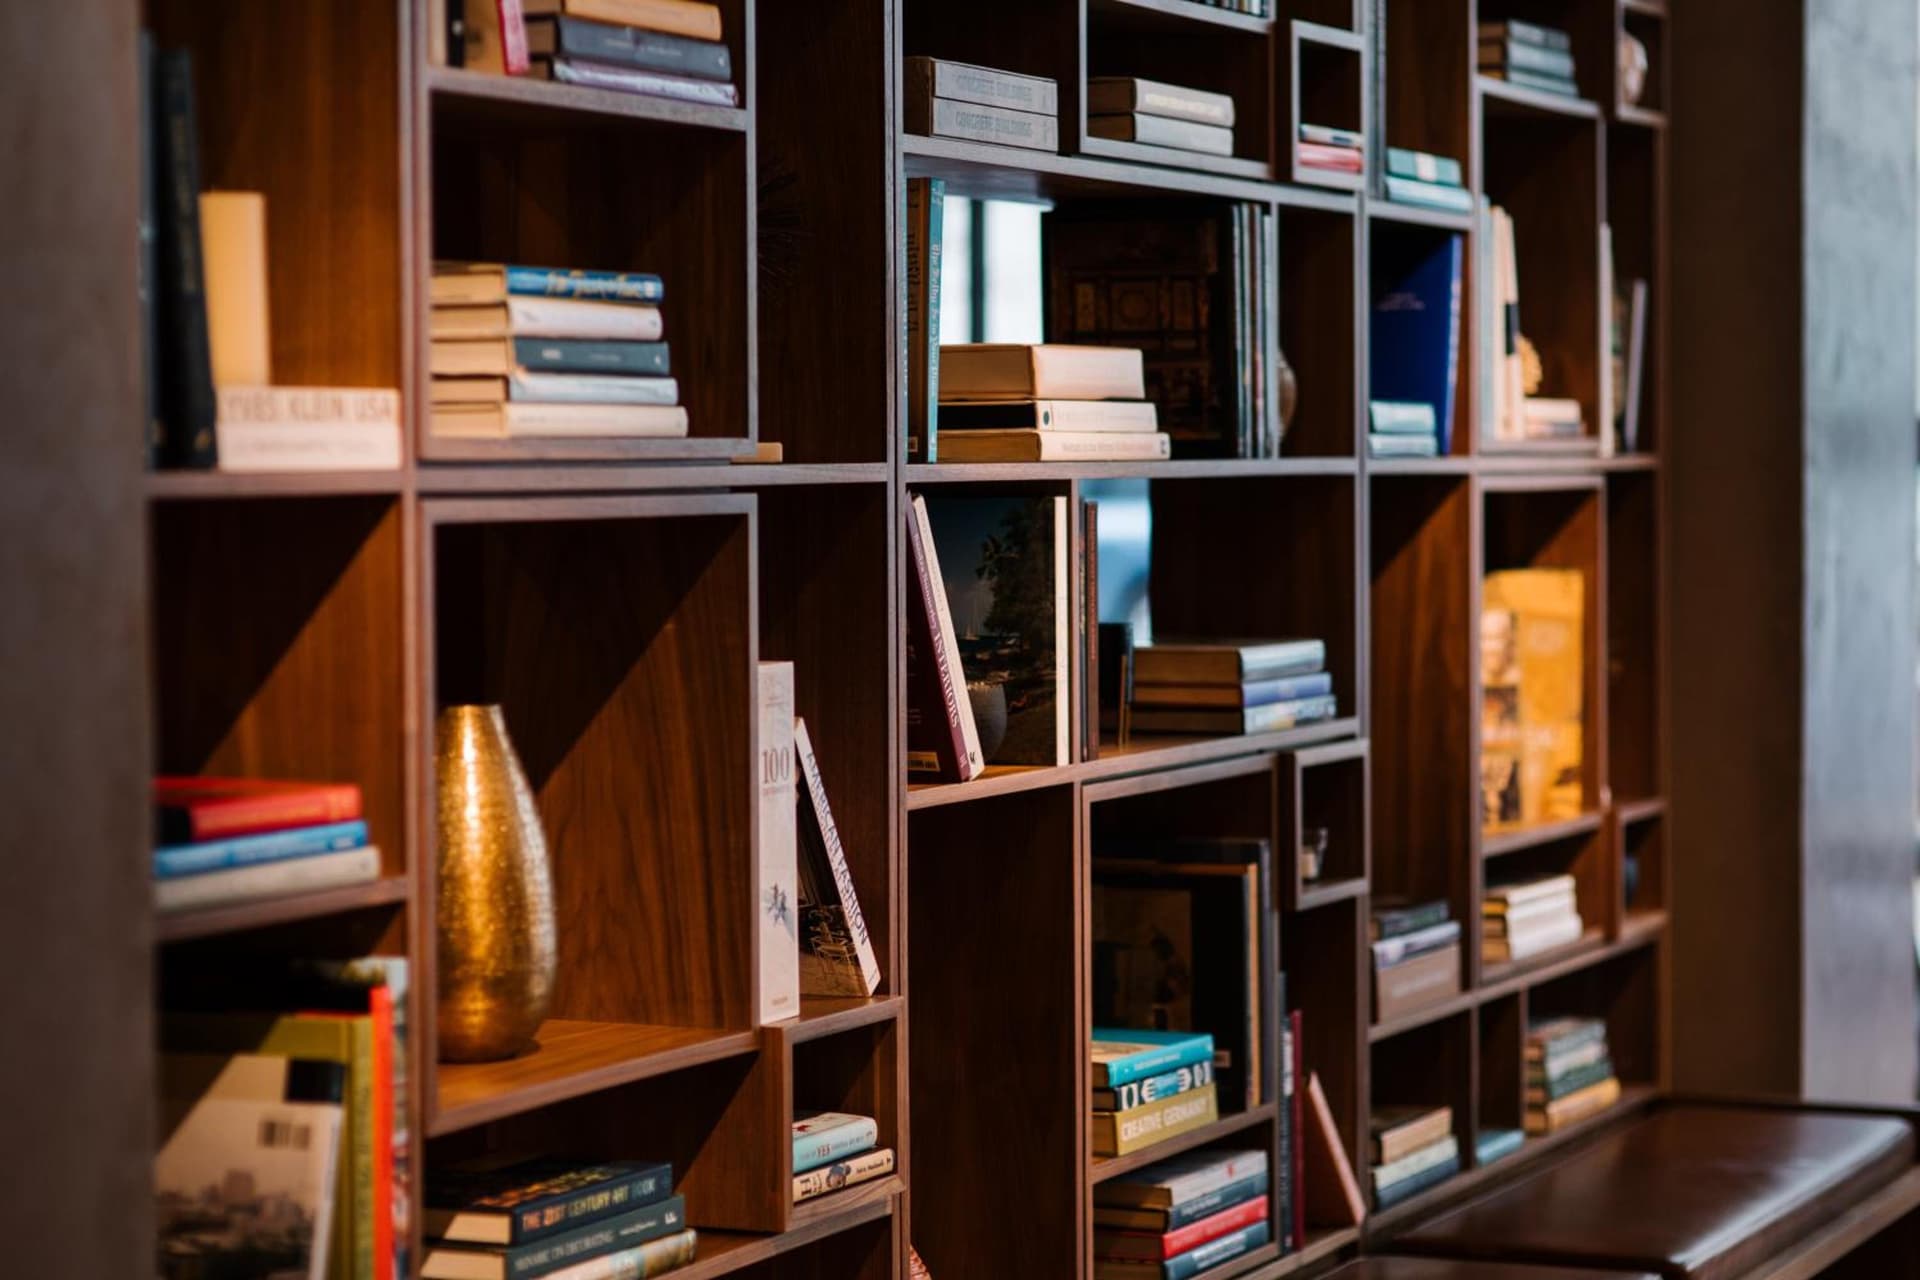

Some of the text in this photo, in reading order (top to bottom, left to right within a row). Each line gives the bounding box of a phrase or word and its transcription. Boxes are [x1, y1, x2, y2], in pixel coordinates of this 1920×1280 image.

[934, 631, 960, 729] INTERIORS
[761, 748, 790, 785] 100
[838, 857, 868, 945] FASHION
[1120, 1096, 1208, 1142] CREATIVE GERMANY
